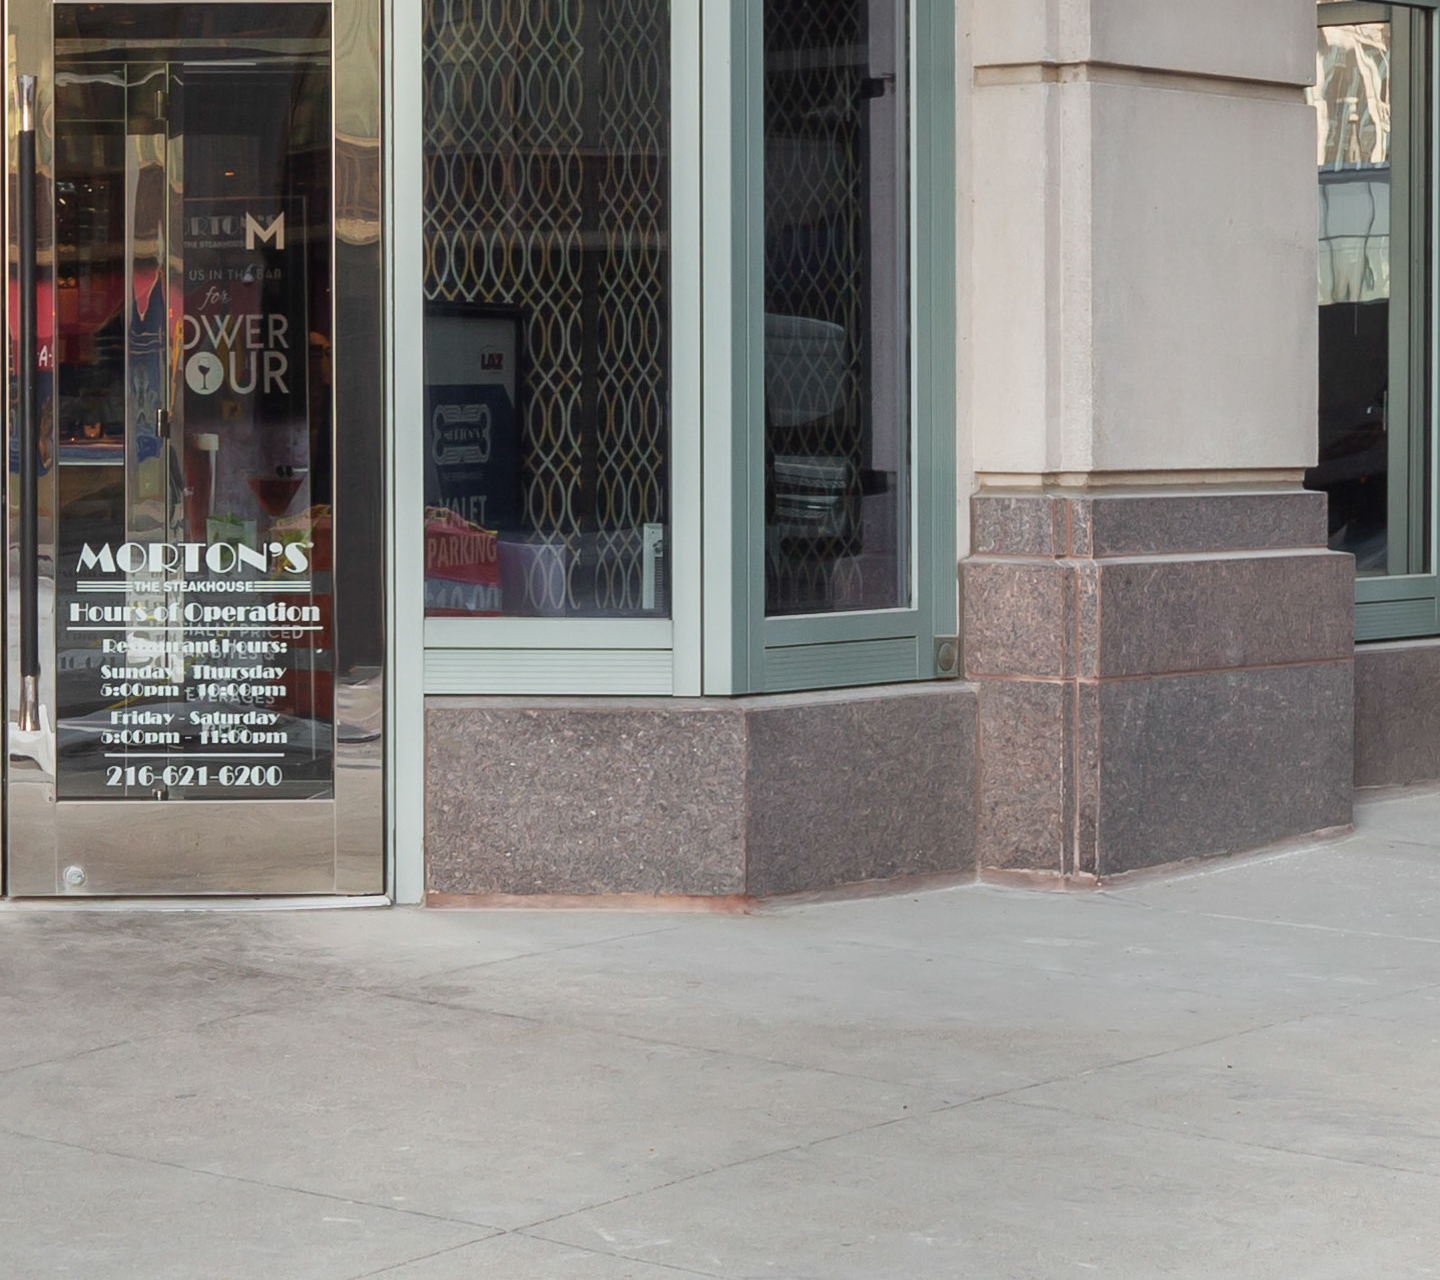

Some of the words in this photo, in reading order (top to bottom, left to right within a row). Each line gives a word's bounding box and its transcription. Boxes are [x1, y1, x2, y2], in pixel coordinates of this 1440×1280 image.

[245, 211, 285, 250] M
[188, 269, 205, 282] US
[209, 269, 223, 281] IN
[227, 269, 249, 280] TH
[183, 313, 289, 351] OWER
[185, 351, 290, 395] OUR
[76, 542, 309, 574] MORTON'S
[427, 534, 497, 569] PARKING
[134, 581, 160, 592] THE
[163, 581, 254, 592] STEAKHOUSE
[70, 602, 147, 622] Hours
[153, 602, 179, 622] of
[184, 601, 321, 622] Operation
[222, 639, 288, 654] Hours:
[101, 664, 176, 679] Sunday
[191, 665, 287, 680] Thursday
[100, 683, 180, 697] 5:00pm
[196, 683, 287, 697] 10:00pm
[110, 711, 175, 726] Friday
[189, 711, 281, 726] Saturday
[199, 729, 288, 745] 11:00pm
[106, 765, 283, 787] 216-621-6200
